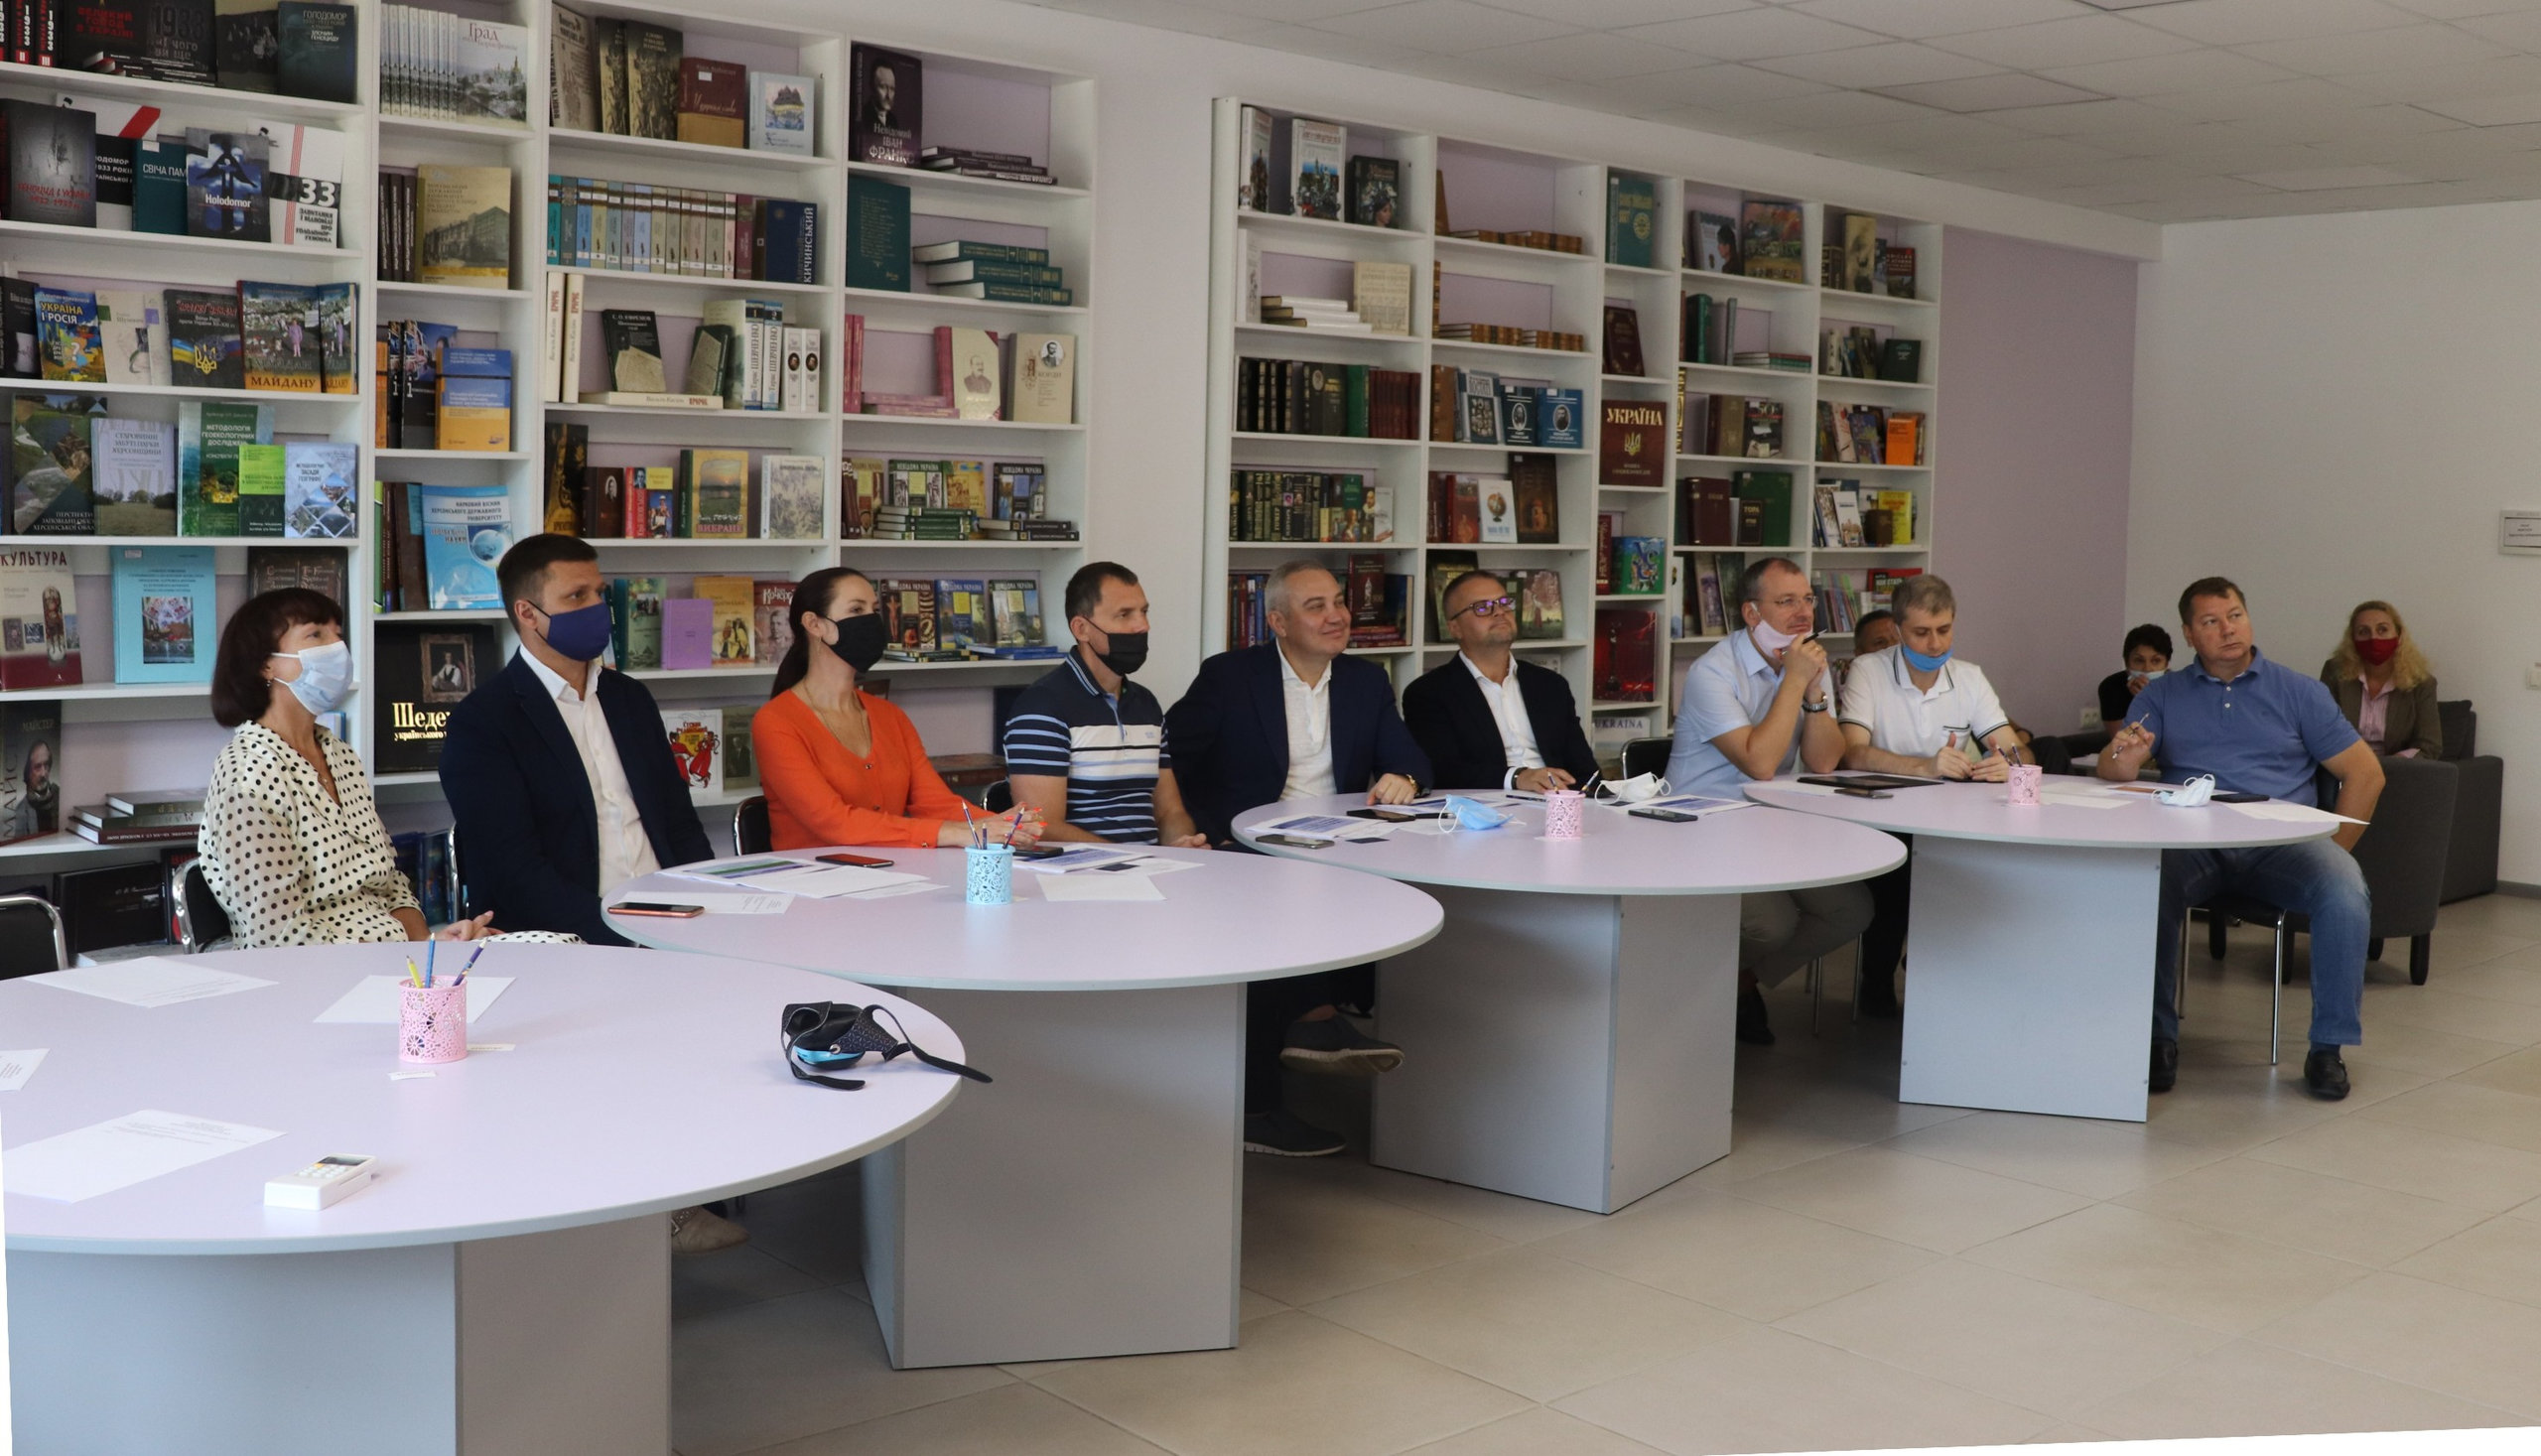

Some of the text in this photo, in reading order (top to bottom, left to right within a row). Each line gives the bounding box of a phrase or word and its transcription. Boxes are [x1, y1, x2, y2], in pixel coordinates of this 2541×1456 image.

[303, 10, 347, 21] ГОЛОДОМОР
[95, 156, 130, 166] ОДОМОР
[143, 164, 188, 178] СВІЧА ПАМ
[299, 178, 336, 207] 33
[204, 193, 253, 209] Holodomor
[802, 205, 817, 284] КИЧИНСЬКИЙ
[40, 302, 83, 316] УКРАЇНА
[48, 313, 78, 325] РОСІЯ
[750, 324, 760, 370] ШЕВЧЕНКО
[768, 326, 778, 372] ШЕВЧЕНКО
[251, 376, 316, 389] МАЙДАНУ
[1606, 408, 1664, 428] УКРАЇНА
[698, 524, 742, 533] ВИБРАНЕ
[0, 551, 68, 568] КУЛЬТУРА
[393, 702, 452, 730] Шеде
